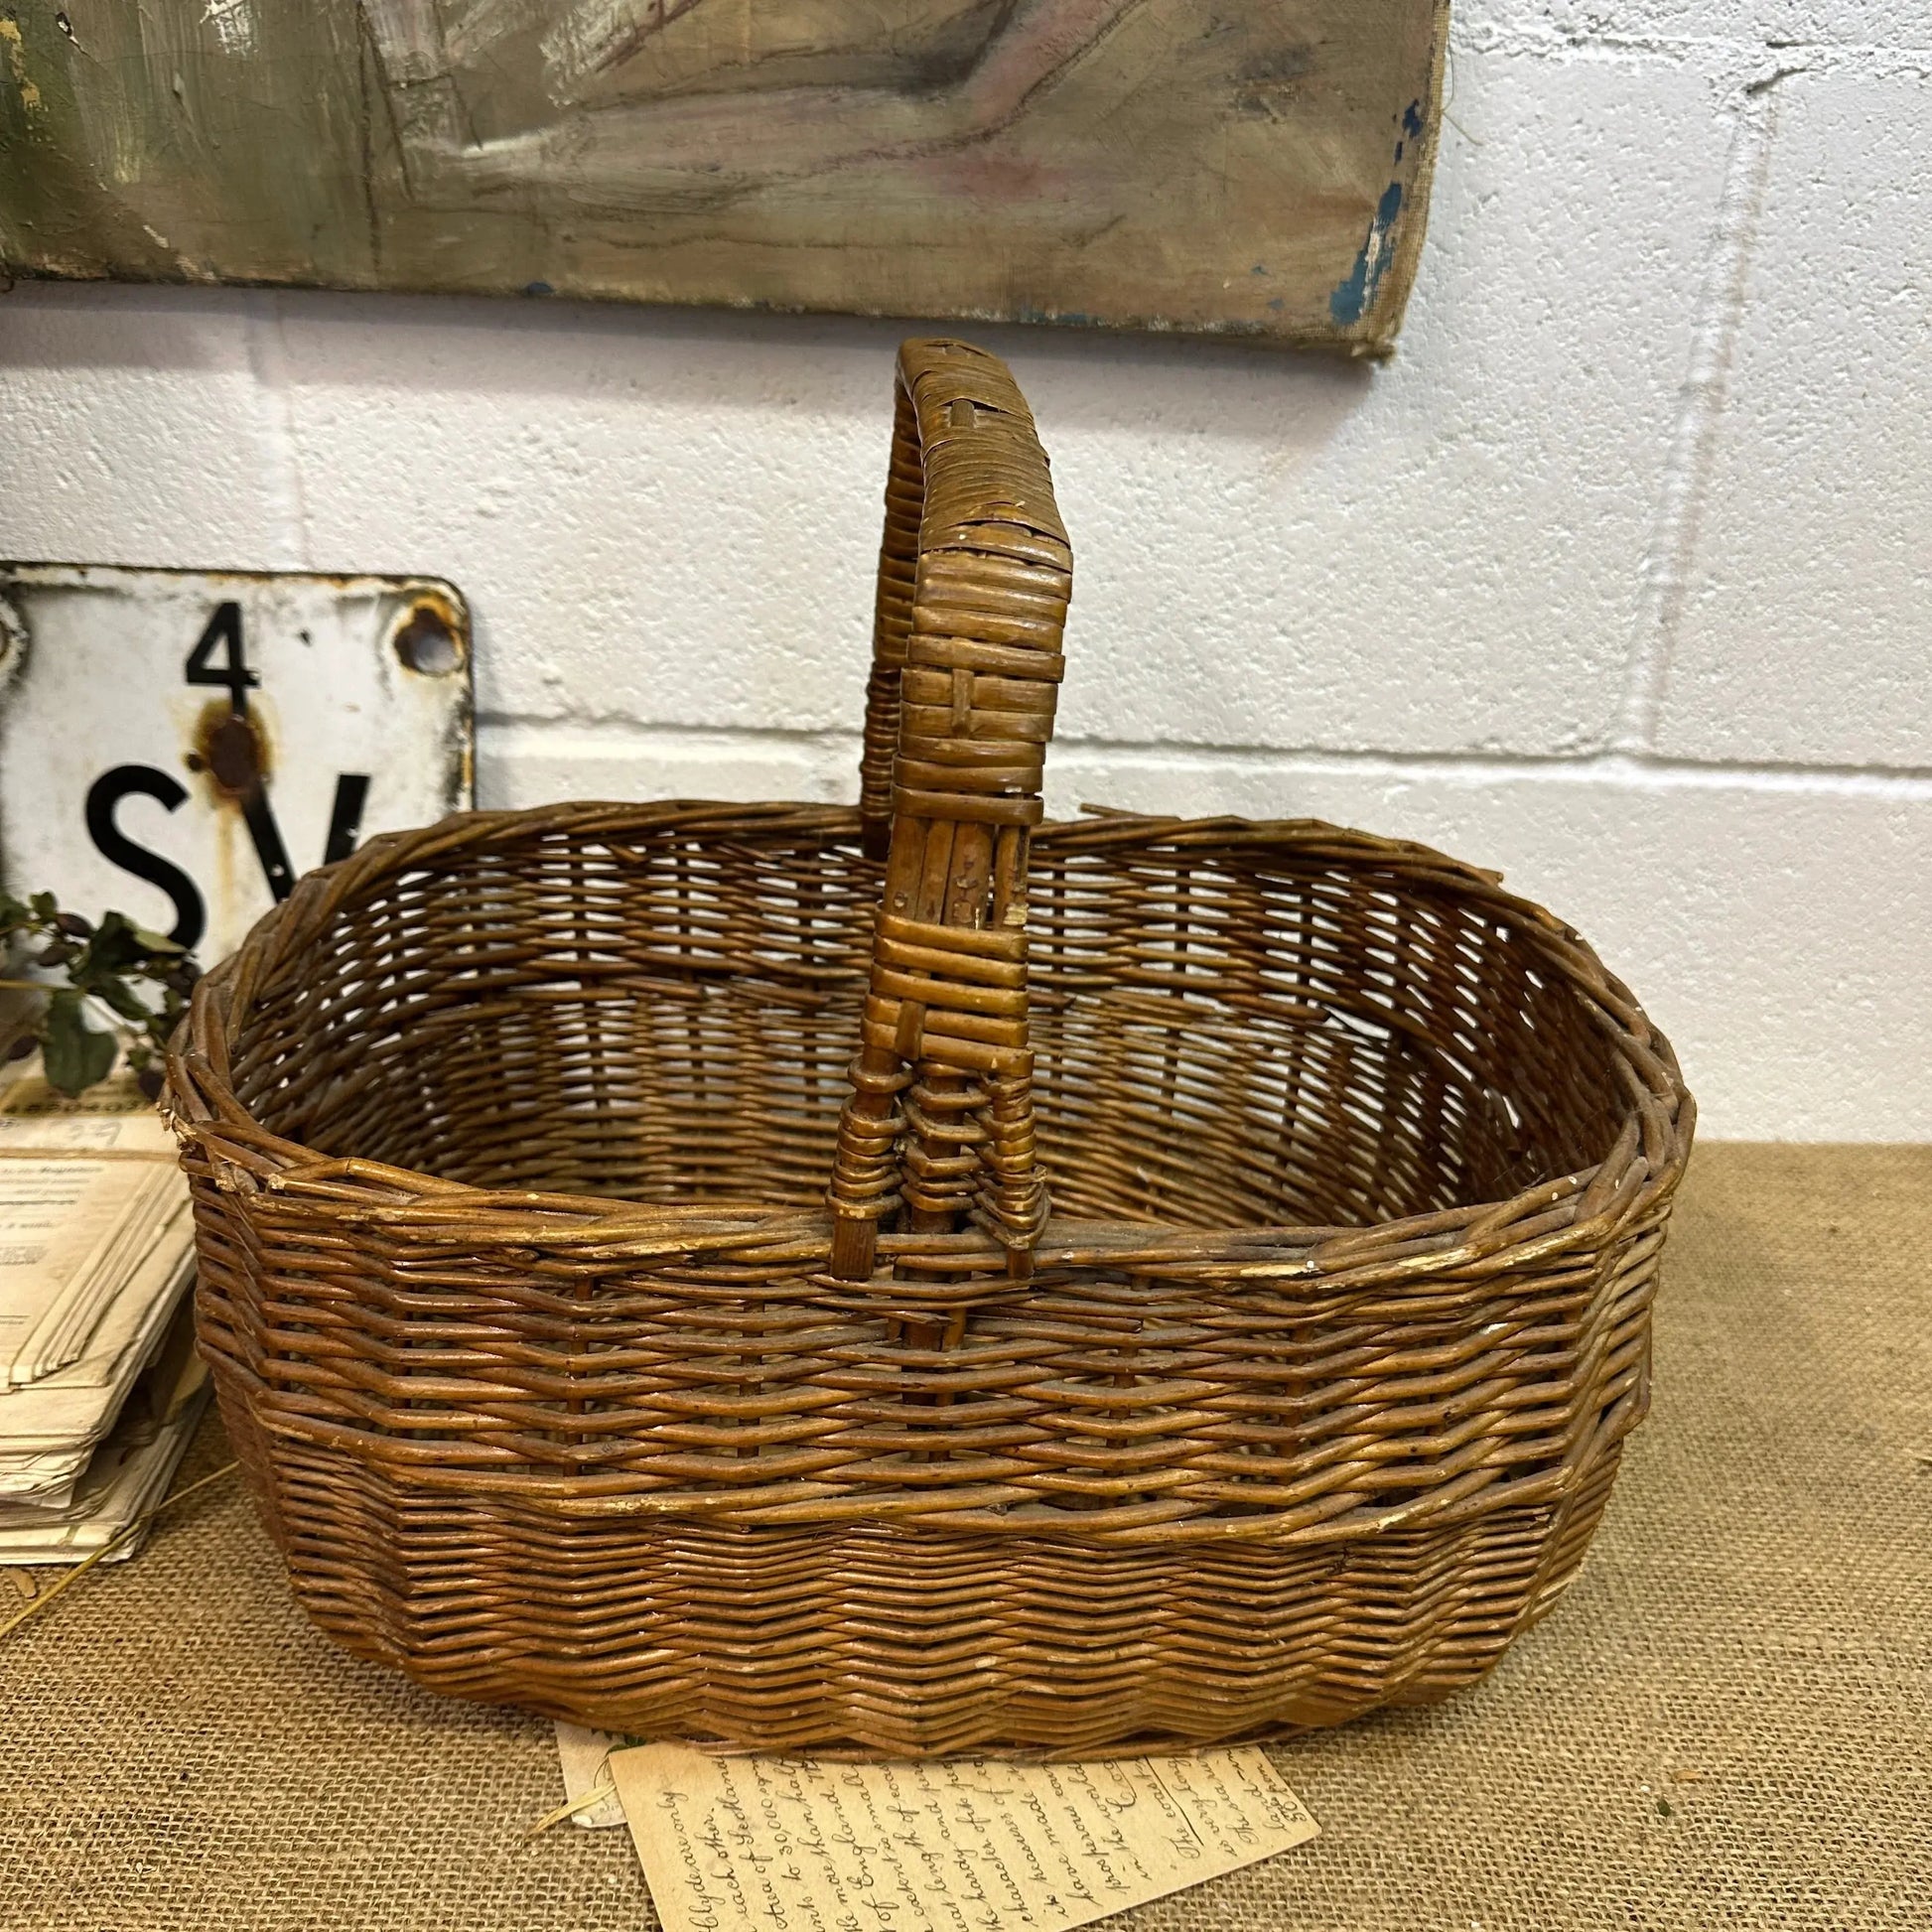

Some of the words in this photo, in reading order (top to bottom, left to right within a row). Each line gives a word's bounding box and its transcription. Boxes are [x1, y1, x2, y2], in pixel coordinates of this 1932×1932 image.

[186, 602, 261, 719] 4
[973, 1786, 1014, 1805] of
[1256, 1762, 1292, 1797] from
[657, 1791, 689, 1837] only
[887, 1802, 919, 1823] of
[924, 1799, 952, 1841] and
[1021, 1790, 1061, 1846] made
[1191, 1794, 1220, 1835] very
[1225, 1817, 1260, 1845] The
[678, 1836, 700, 1871] are
[797, 1806, 835, 1862] than
[1064, 1805, 1131, 1894] prosperous
[1102, 1827, 1130, 1852] the
[1168, 1827, 1200, 1860] The
[739, 1848, 773, 1873] of
[781, 1863, 802, 1881] to
[894, 1828, 953, 1894] length
[953, 1842, 991, 1904] hardy
[1059, 1852, 1103, 1906] have
[1122, 1851, 1152, 1880] in
[685, 1872, 726, 1932] Clyde
[711, 1866, 750, 1919] each
[762, 1877, 787, 1930] Area
[823, 1863, 848, 1904] more
[882, 1858, 929, 1918] extent
[981, 1839, 1038, 1928] character
[862, 1893, 899, 1921] of
